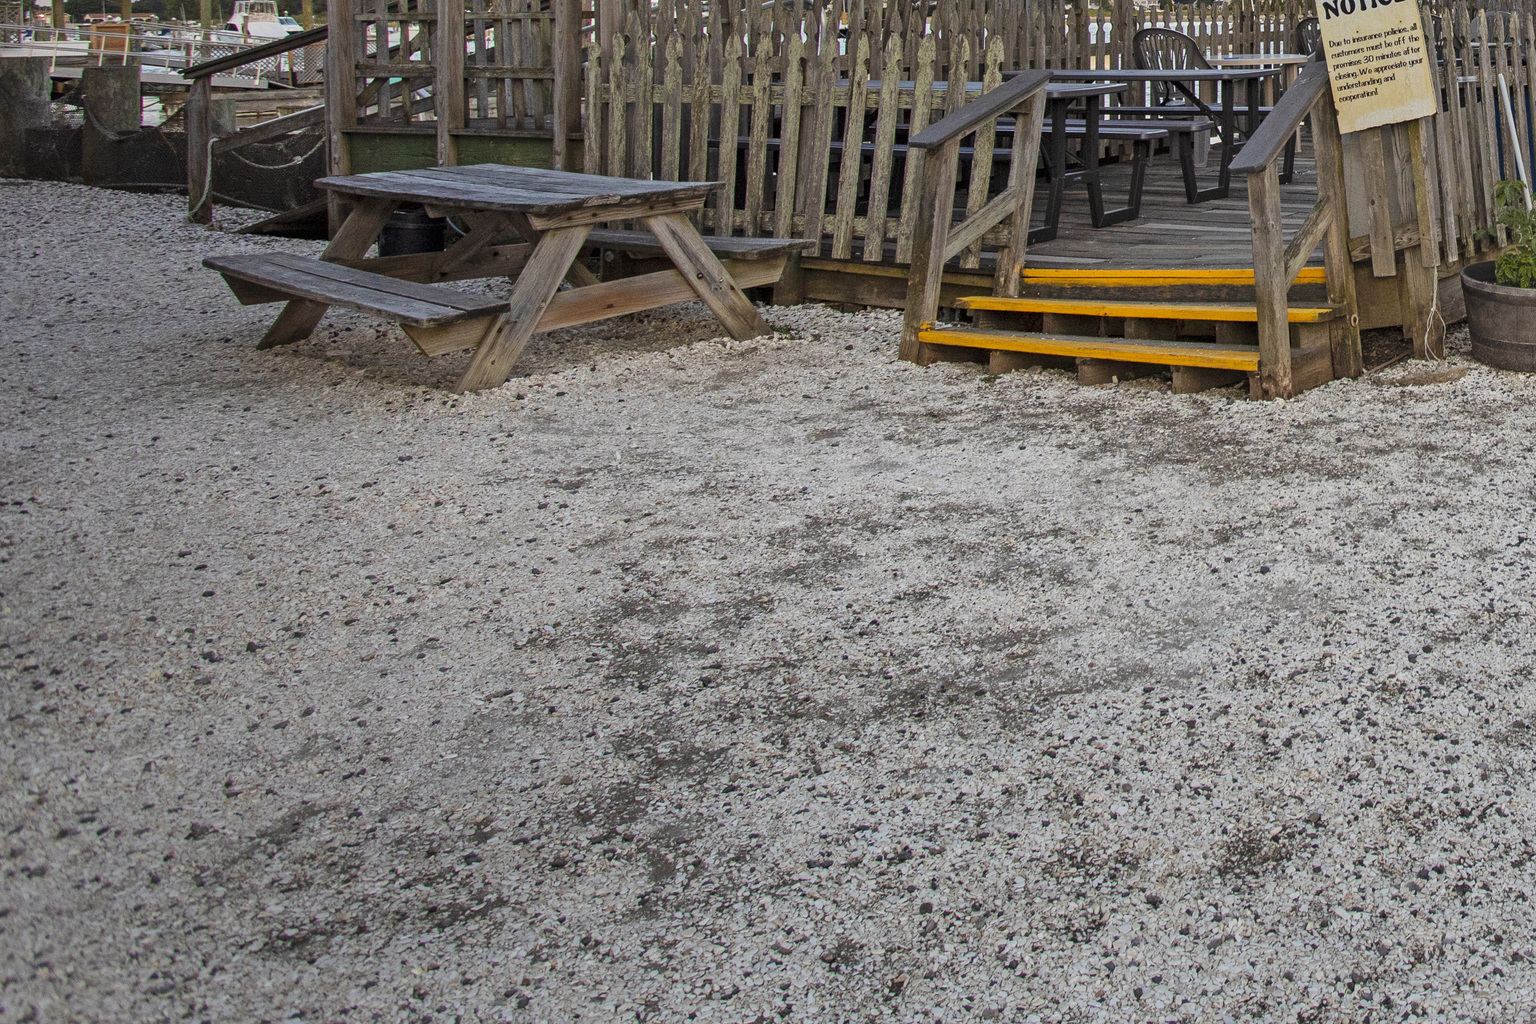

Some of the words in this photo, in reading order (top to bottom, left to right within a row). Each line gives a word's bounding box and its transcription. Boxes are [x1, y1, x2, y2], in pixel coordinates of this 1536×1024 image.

[1328, 40, 1342, 48] Due
[1352, 32, 1382, 43] insurance
[1409, 22, 1418, 31] all
[1331, 47, 1365, 59] customers
[1366, 42, 1382, 52] must
[1384, 40, 1393, 48] be
[1408, 34, 1420, 42] the
[1332, 59, 1362, 71] premises
[1363, 55, 1374, 63] 30
[1375, 51, 1401, 61] minutes
[1403, 46, 1421, 56] after
[1359, 67, 1372, 75] We
[1373, 60, 1407, 73] appreciate
[1408, 57, 1424, 68] your
[1336, 77, 1382, 92] understanding
[1383, 72, 1396, 82] and
